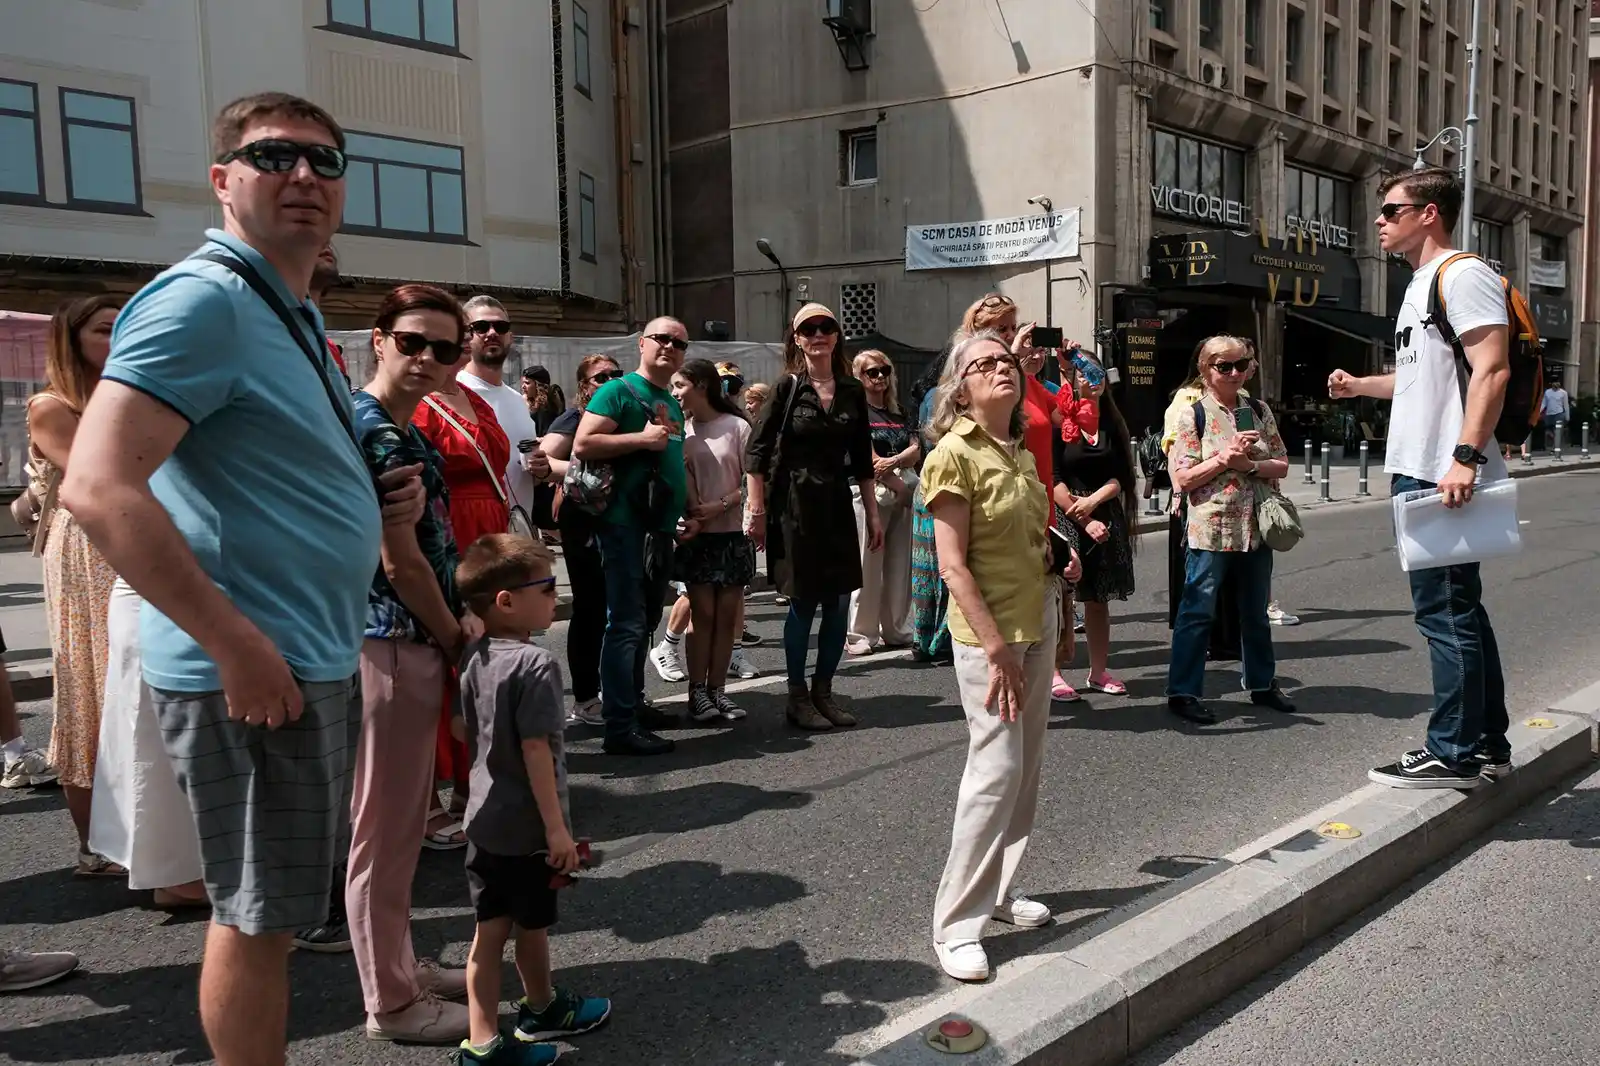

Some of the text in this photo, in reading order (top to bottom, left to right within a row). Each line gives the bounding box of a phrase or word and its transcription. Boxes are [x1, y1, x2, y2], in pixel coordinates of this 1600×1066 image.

[1149, 182, 1348, 248] VICTORIEI EVENTS
[922, 214, 1063, 240] SCM CASA DE MODĂ VENUS
[995, 238, 1021, 249] PENTRU
[1127, 335, 1156, 345] EXCHANGE
[1130, 351, 1153, 360] AMANET
[1128, 365, 1156, 374] TRANSFER
[1131, 376, 1139, 385] DE
